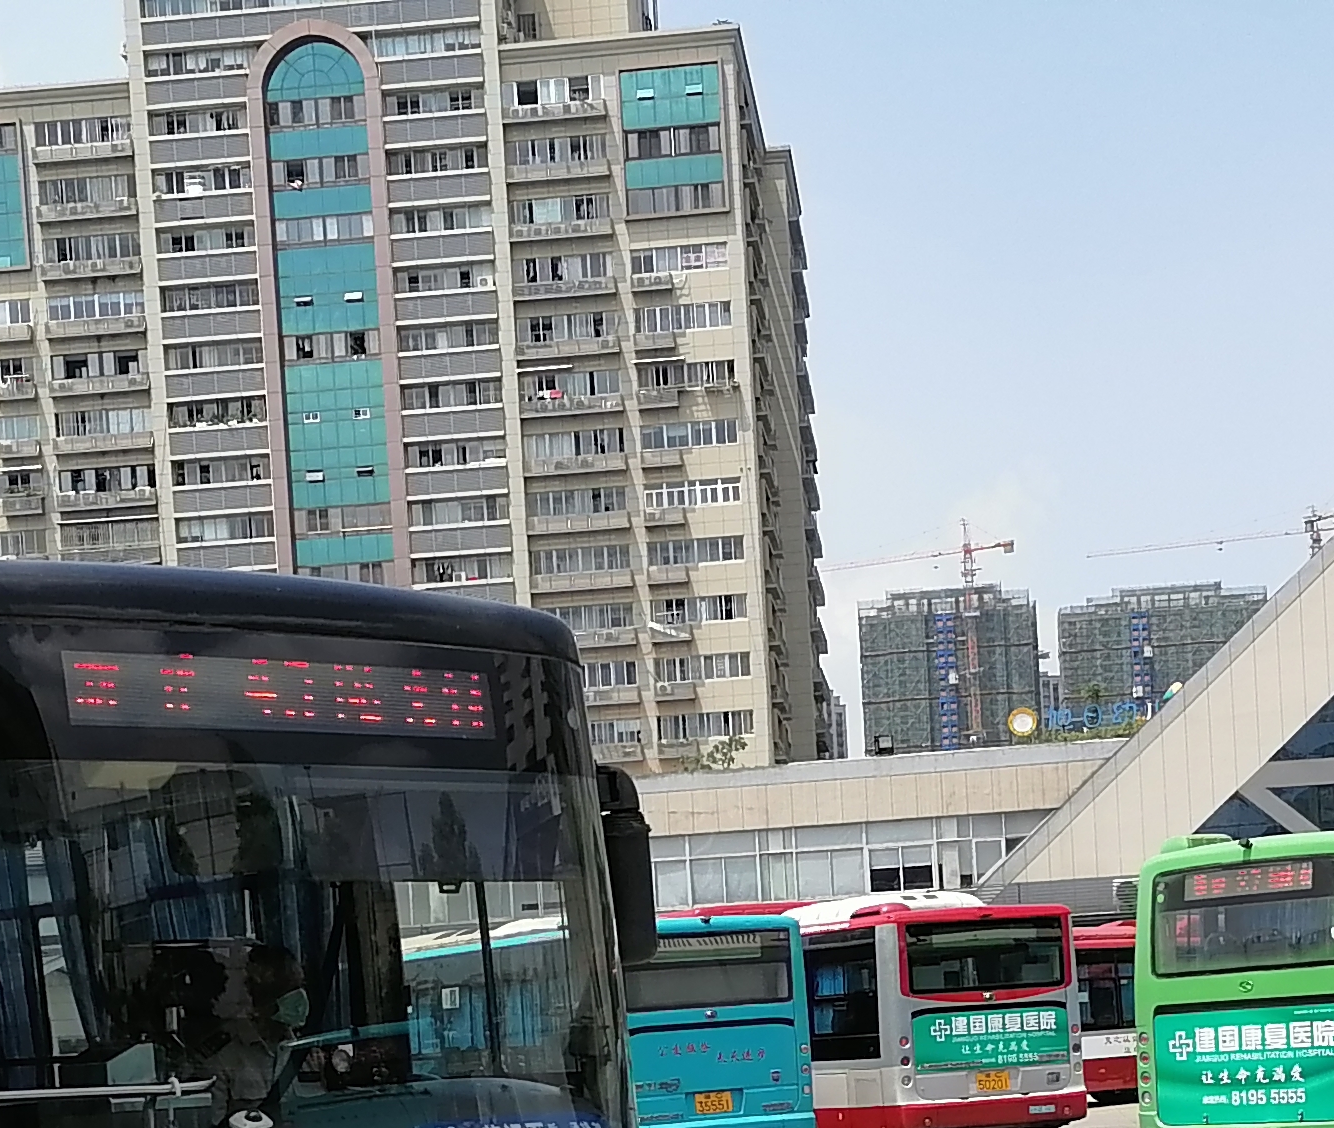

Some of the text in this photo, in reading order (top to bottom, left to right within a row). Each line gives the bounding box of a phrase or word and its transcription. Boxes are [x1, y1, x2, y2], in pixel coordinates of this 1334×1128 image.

[952, 1010, 1057, 1036] 建国康复医院
[1201, 1063, 1306, 1084] 让生命充满爱
[978, 1078, 1009, 1090] 50201
[697, 1099, 731, 1113] 35551
[1231, 1088, 1267, 1106] 8195
[1270, 1087, 1306, 1105] 5555
